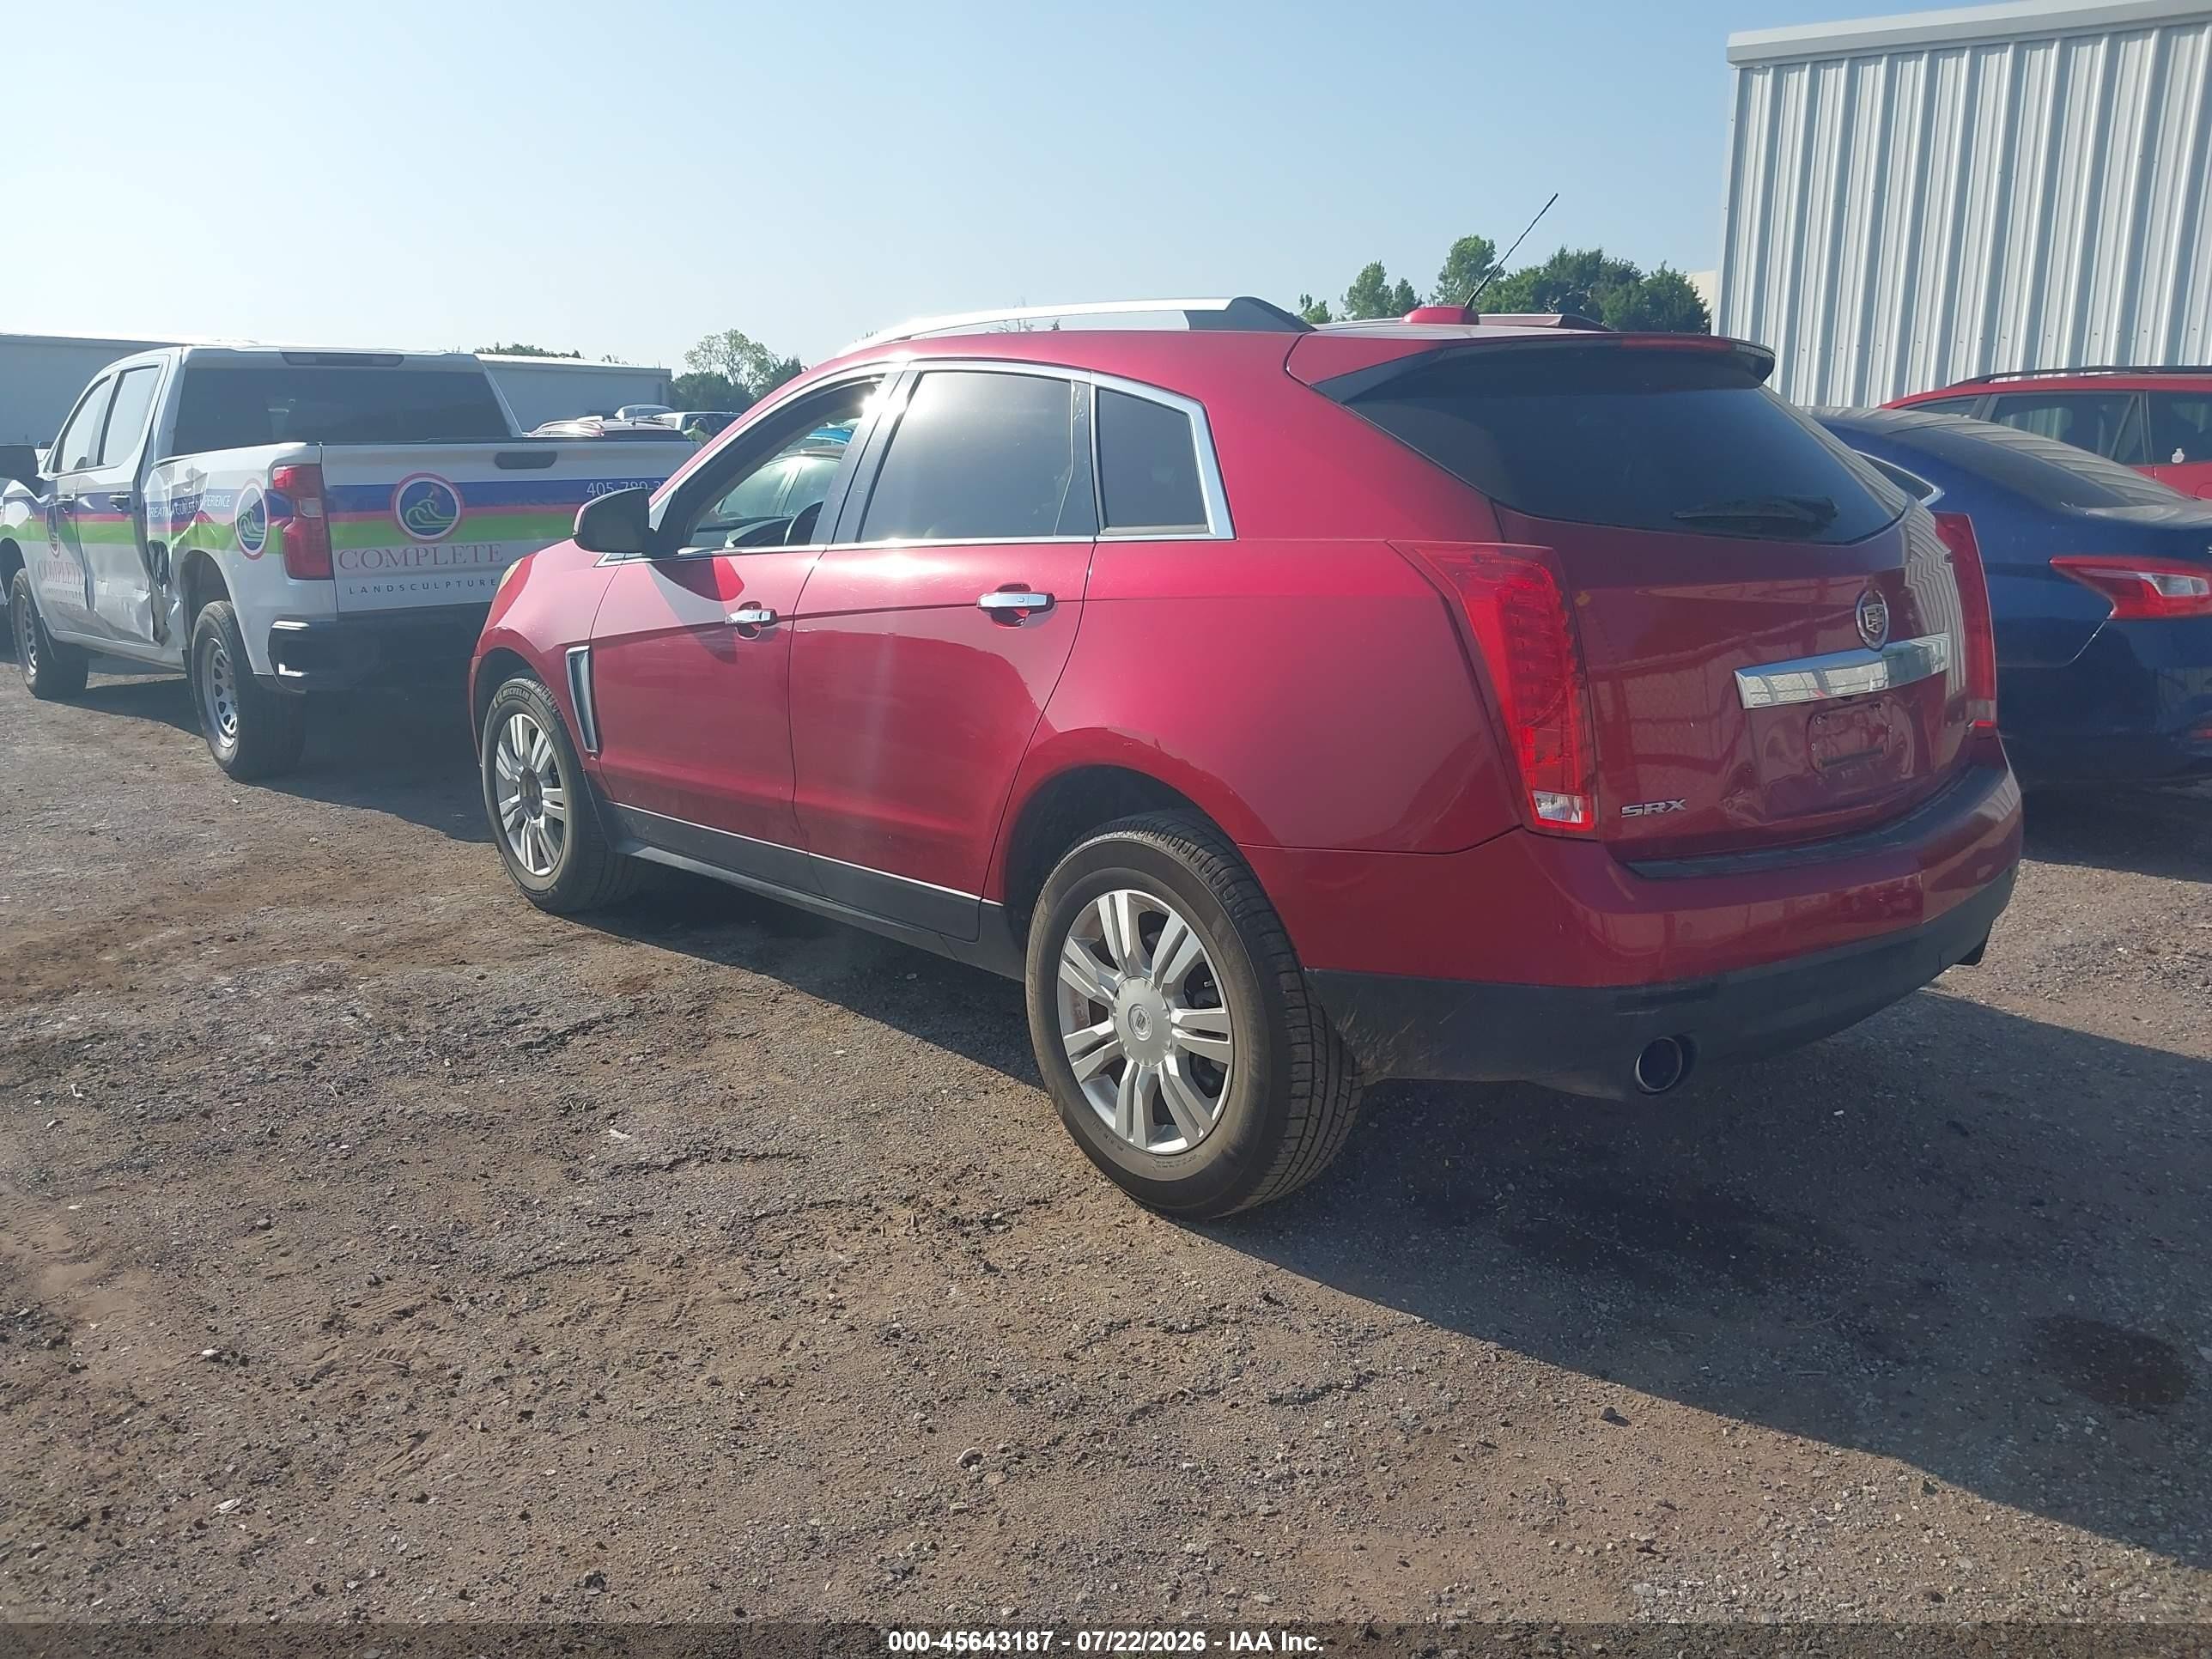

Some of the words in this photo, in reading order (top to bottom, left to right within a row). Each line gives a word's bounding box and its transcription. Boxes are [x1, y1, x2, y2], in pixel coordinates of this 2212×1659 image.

[337, 543, 503, 570] COMPLETE
[349, 577, 496, 595] LANDSCULPTURE
[501, 687, 531, 702] MICHELIN
[1620, 798, 1686, 818] SRX
